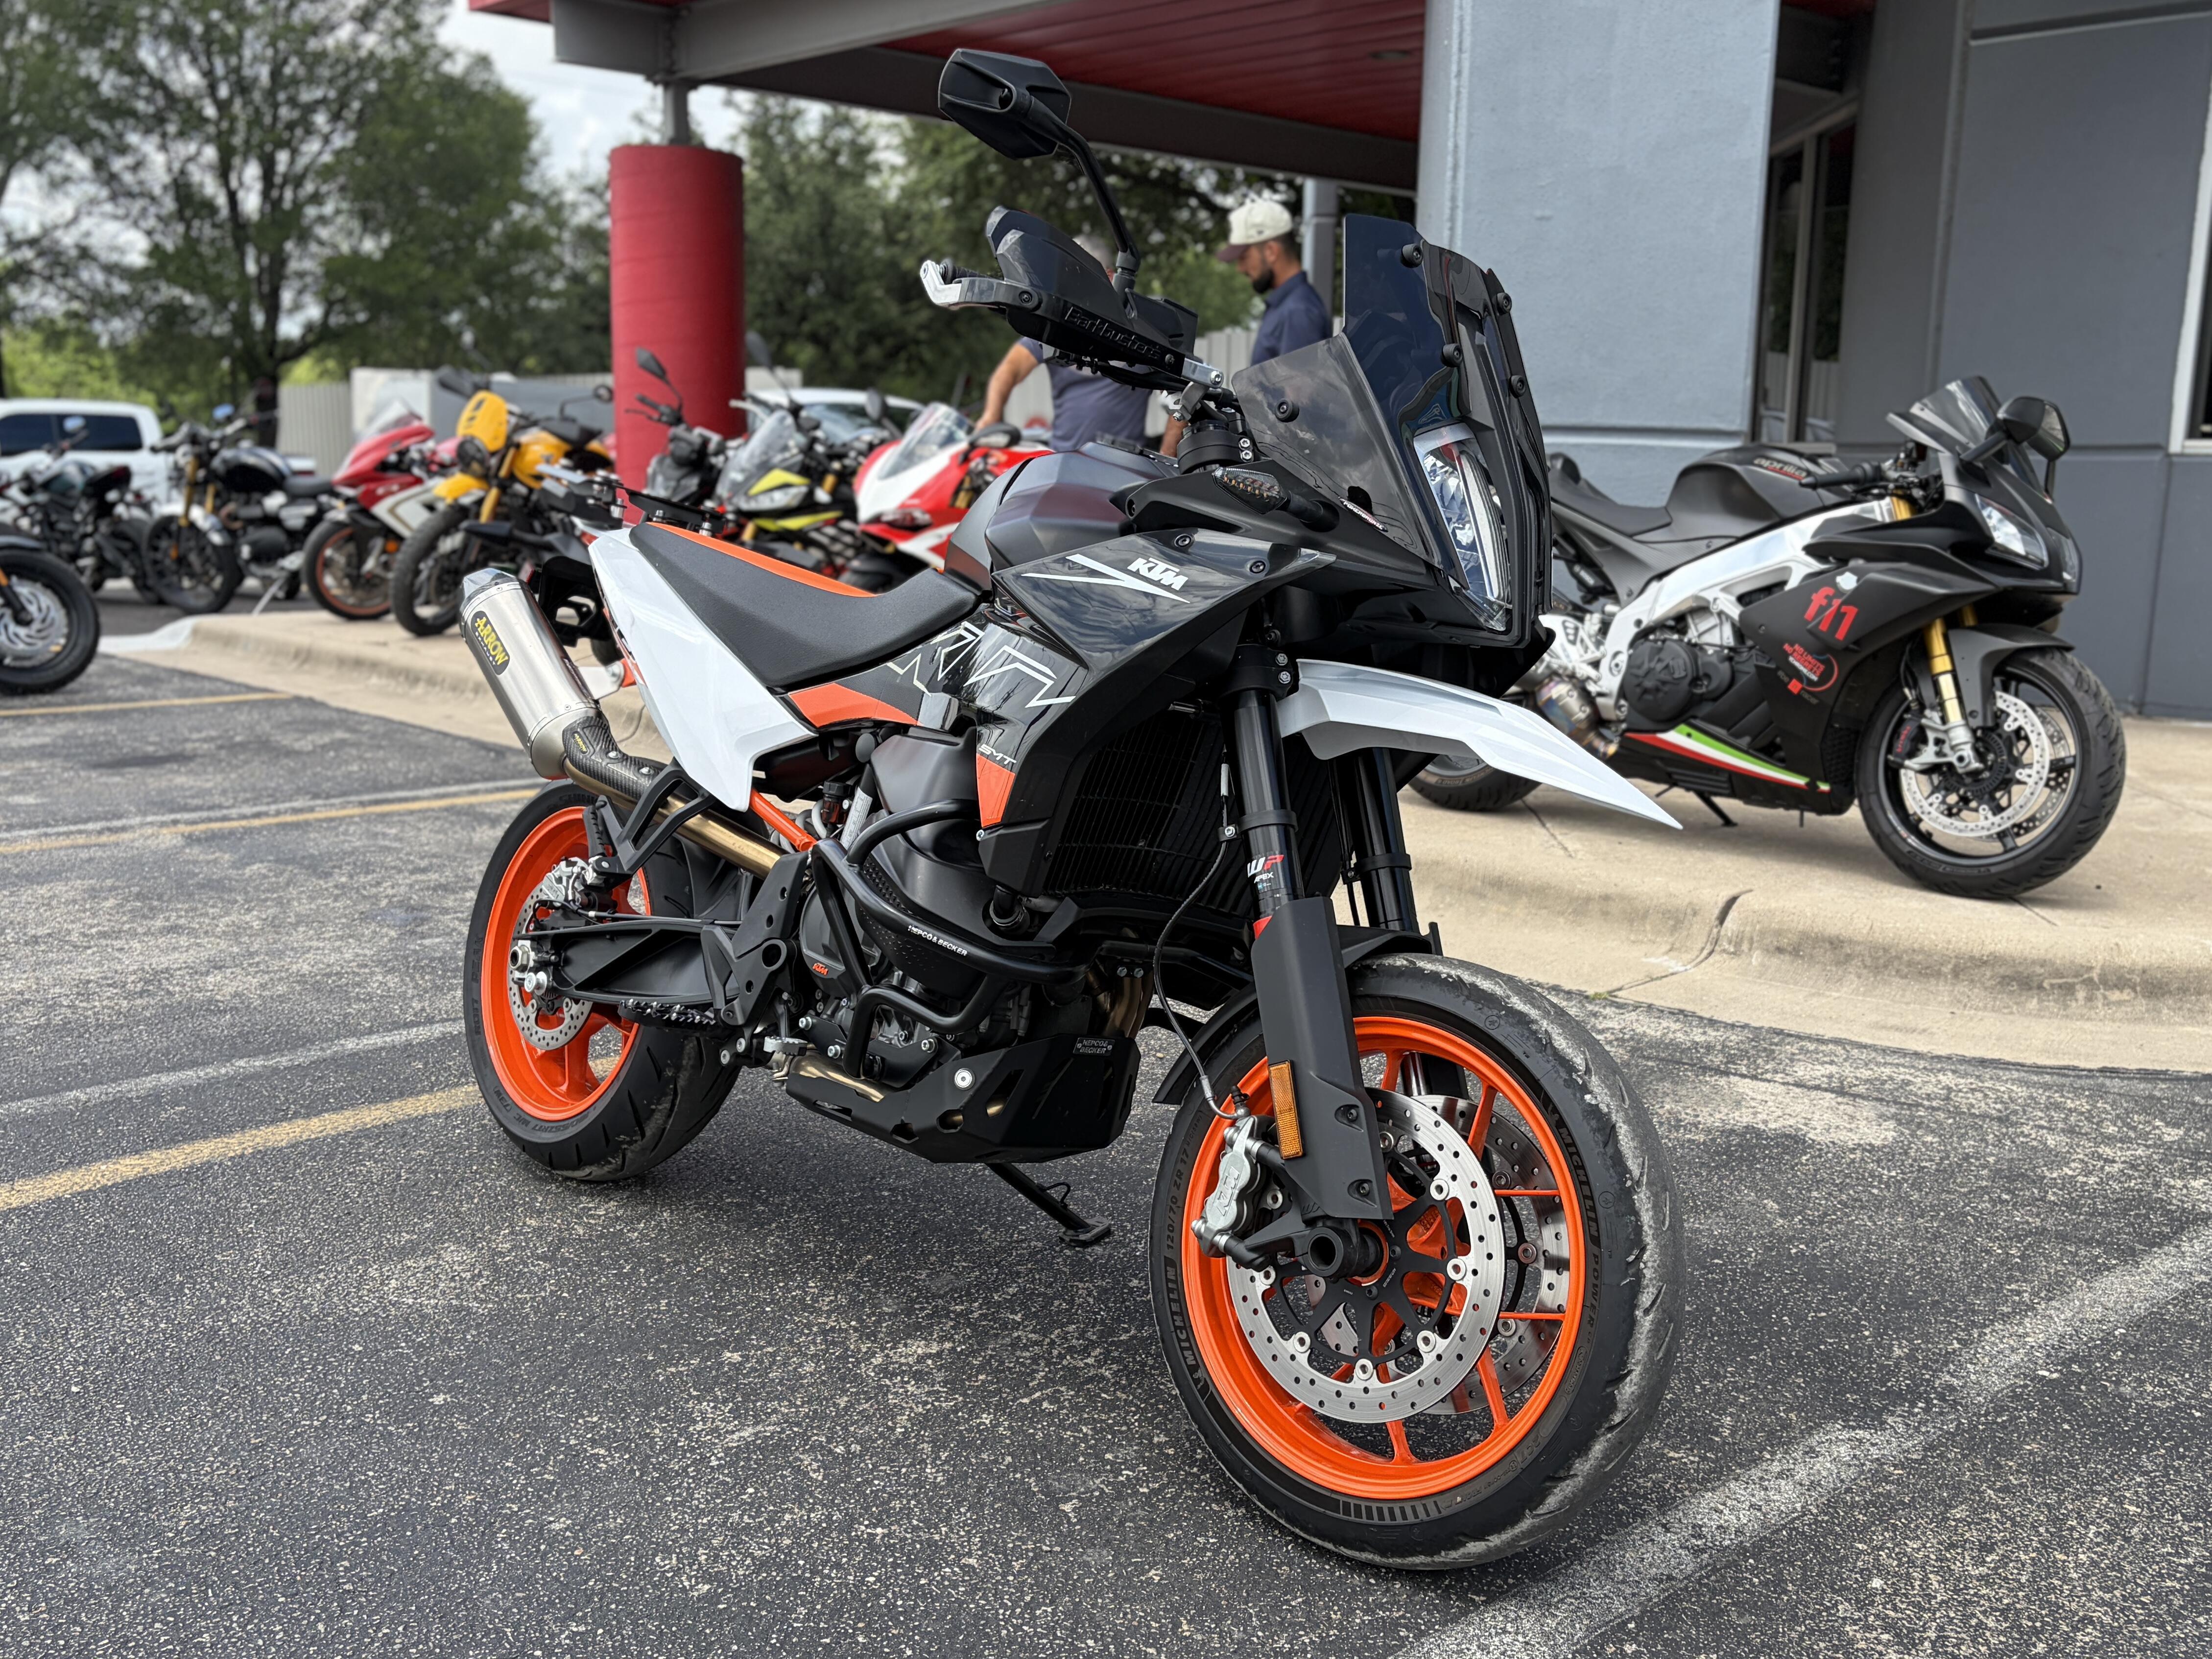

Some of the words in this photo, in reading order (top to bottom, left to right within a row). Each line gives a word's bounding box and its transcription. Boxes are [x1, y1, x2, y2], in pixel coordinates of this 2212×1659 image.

[1065, 306, 1162, 359] Barkbusters
[1754, 457, 1808, 477] aprilia
[1127, 557, 1189, 591] KTM
[475, 616, 508, 665] ARROW
[1793, 643, 1804, 655] NO
[1803, 652, 1825, 672] LIMITS
[1783, 643, 1793, 654] NO
[1792, 652, 1822, 677] REGRETS
[978, 743, 1017, 765] SMT
[1247, 854, 1284, 878] WP
[1254, 872, 1274, 884] APEX
[812, 962, 828, 975] KTM
[1167, 1195, 1178, 1250] 120/70
[1173, 1169, 1184, 1191] ZR
[1180, 1148, 1189, 1165] 17
[1217, 1165, 1240, 1216] KTM
[1559, 1127, 1598, 1236] MICHELIN
[1587, 1253, 1599, 1327] POWER
[1166, 1266, 1196, 1365] MICHELIN
